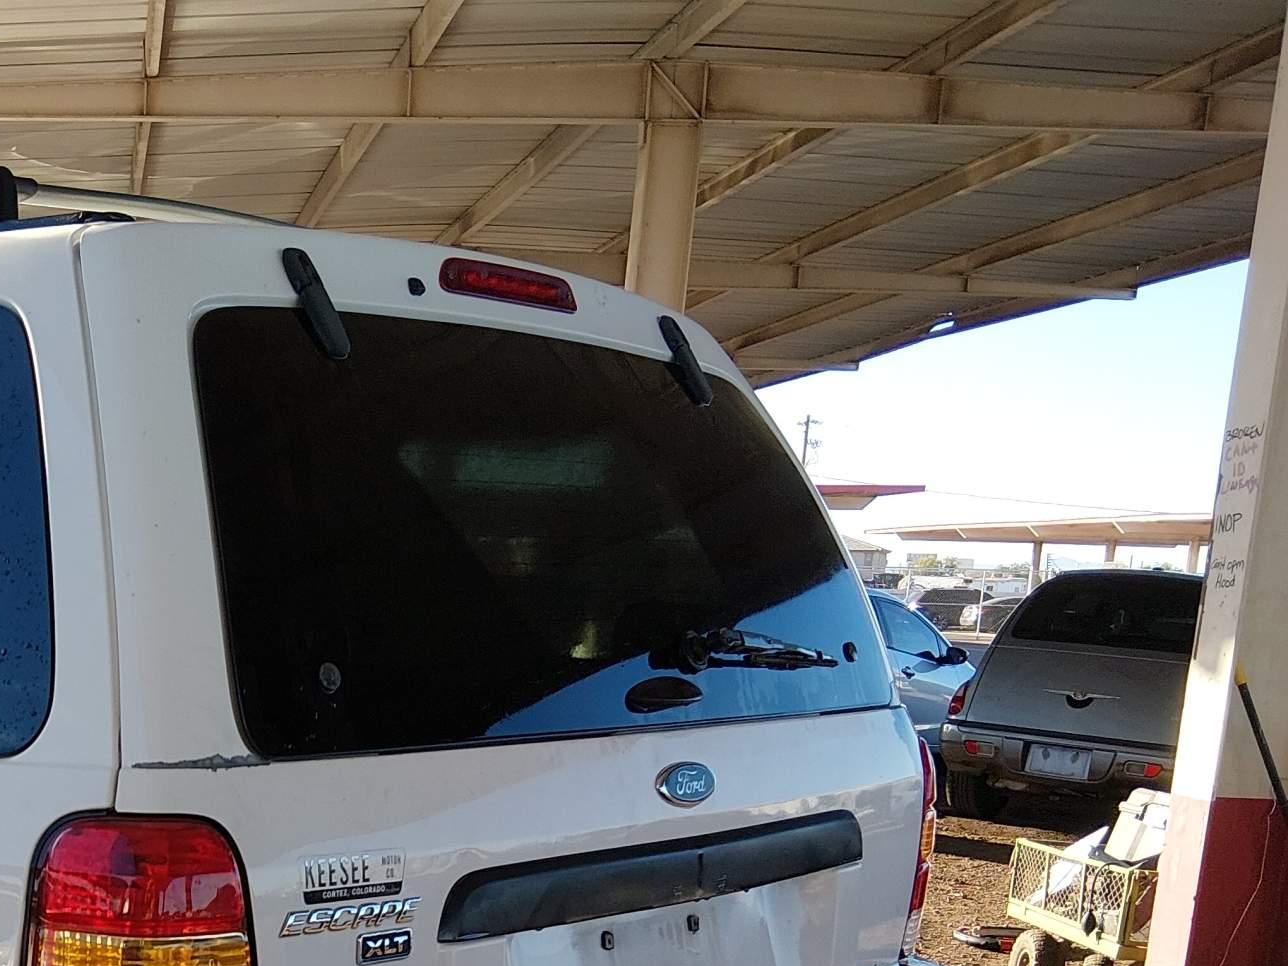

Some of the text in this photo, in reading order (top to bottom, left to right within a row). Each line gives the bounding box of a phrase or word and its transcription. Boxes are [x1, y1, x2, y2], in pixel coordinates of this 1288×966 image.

[1215, 512, 1243, 534] INOP
[676, 770, 706, 795] Ford
[304, 854, 371, 889] KEESEE
[351, 885, 386, 897] COLORADO
[278, 896, 423, 939] ESCAPE
[364, 935, 409, 958] XLT
